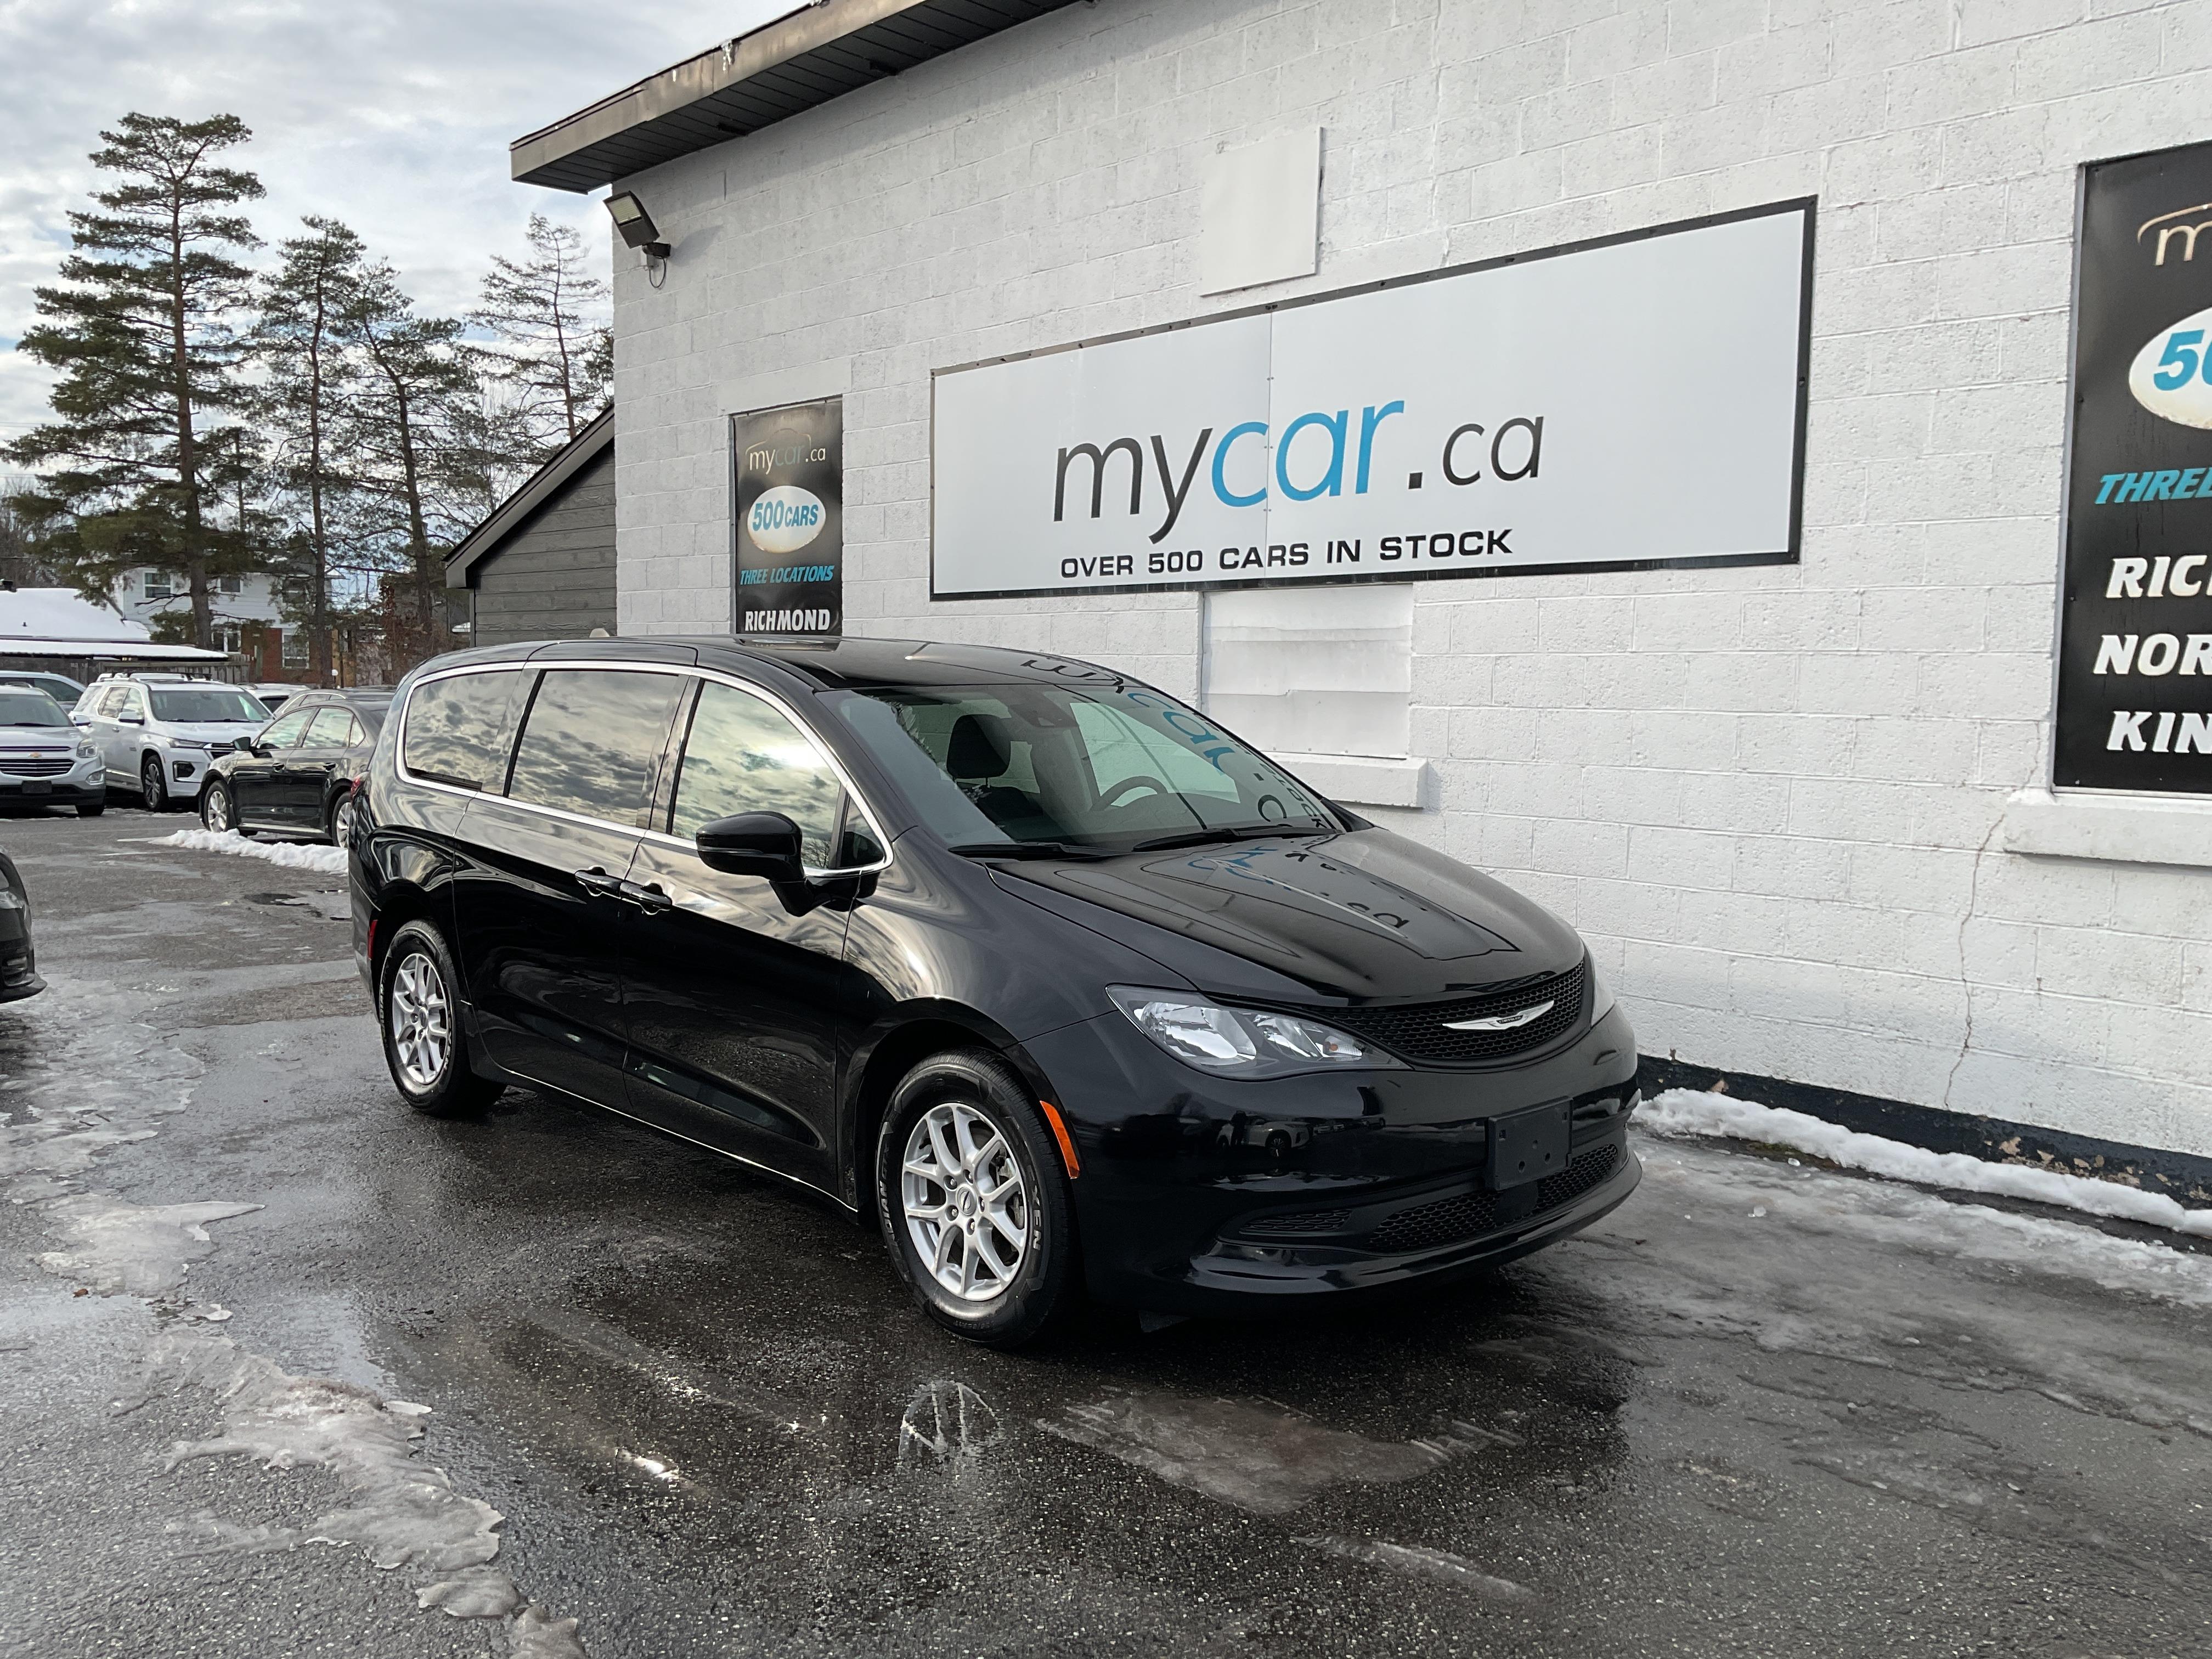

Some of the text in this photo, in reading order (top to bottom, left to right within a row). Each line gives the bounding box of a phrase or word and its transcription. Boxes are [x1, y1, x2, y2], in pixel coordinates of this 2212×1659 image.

[749, 445, 826, 475] mycar.ca
[1053, 400, 1544, 545] mycar.ca
[740, 565, 835, 585] THREE LOCATIONS
[1061, 528, 1514, 579] OVER 500 CARS IN STOCK
[2106, 555, 2212, 599] RIC
[744, 608, 831, 631] RICHMOND
[2093, 633, 2212, 676] NOR
[2106, 710, 2212, 754] KIN
[1025, 1153, 1042, 1251] EXEN
